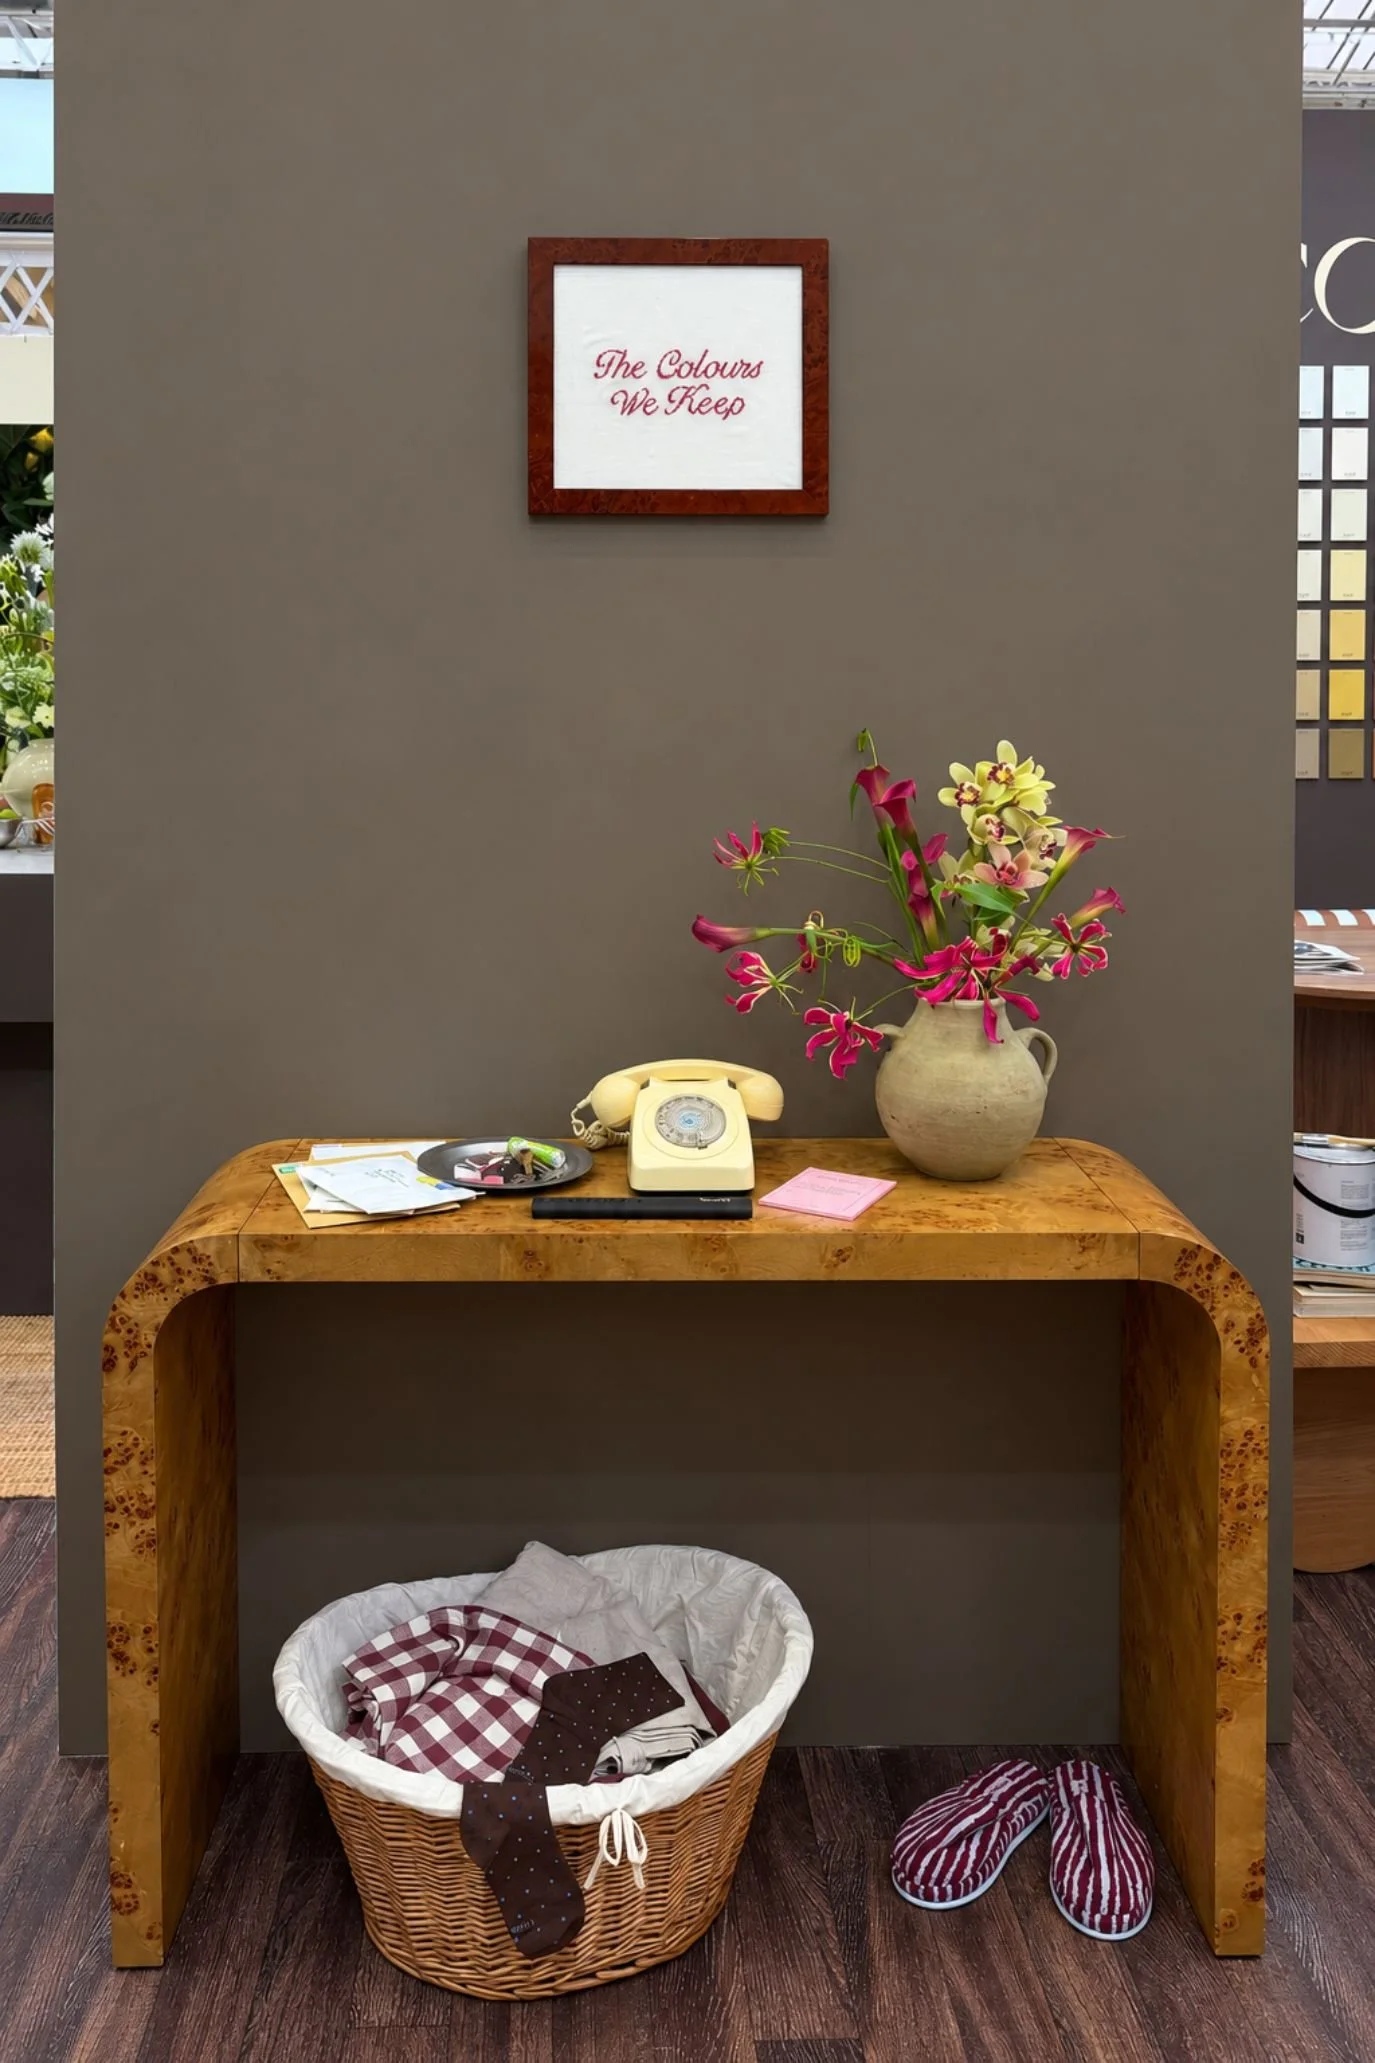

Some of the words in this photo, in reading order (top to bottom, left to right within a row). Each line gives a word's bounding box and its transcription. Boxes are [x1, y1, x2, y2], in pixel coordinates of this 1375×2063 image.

[593, 349, 647, 379] The
[656, 349, 764, 380] Colours
[610, 388, 659, 416] We
[664, 383, 745, 420] Keep
